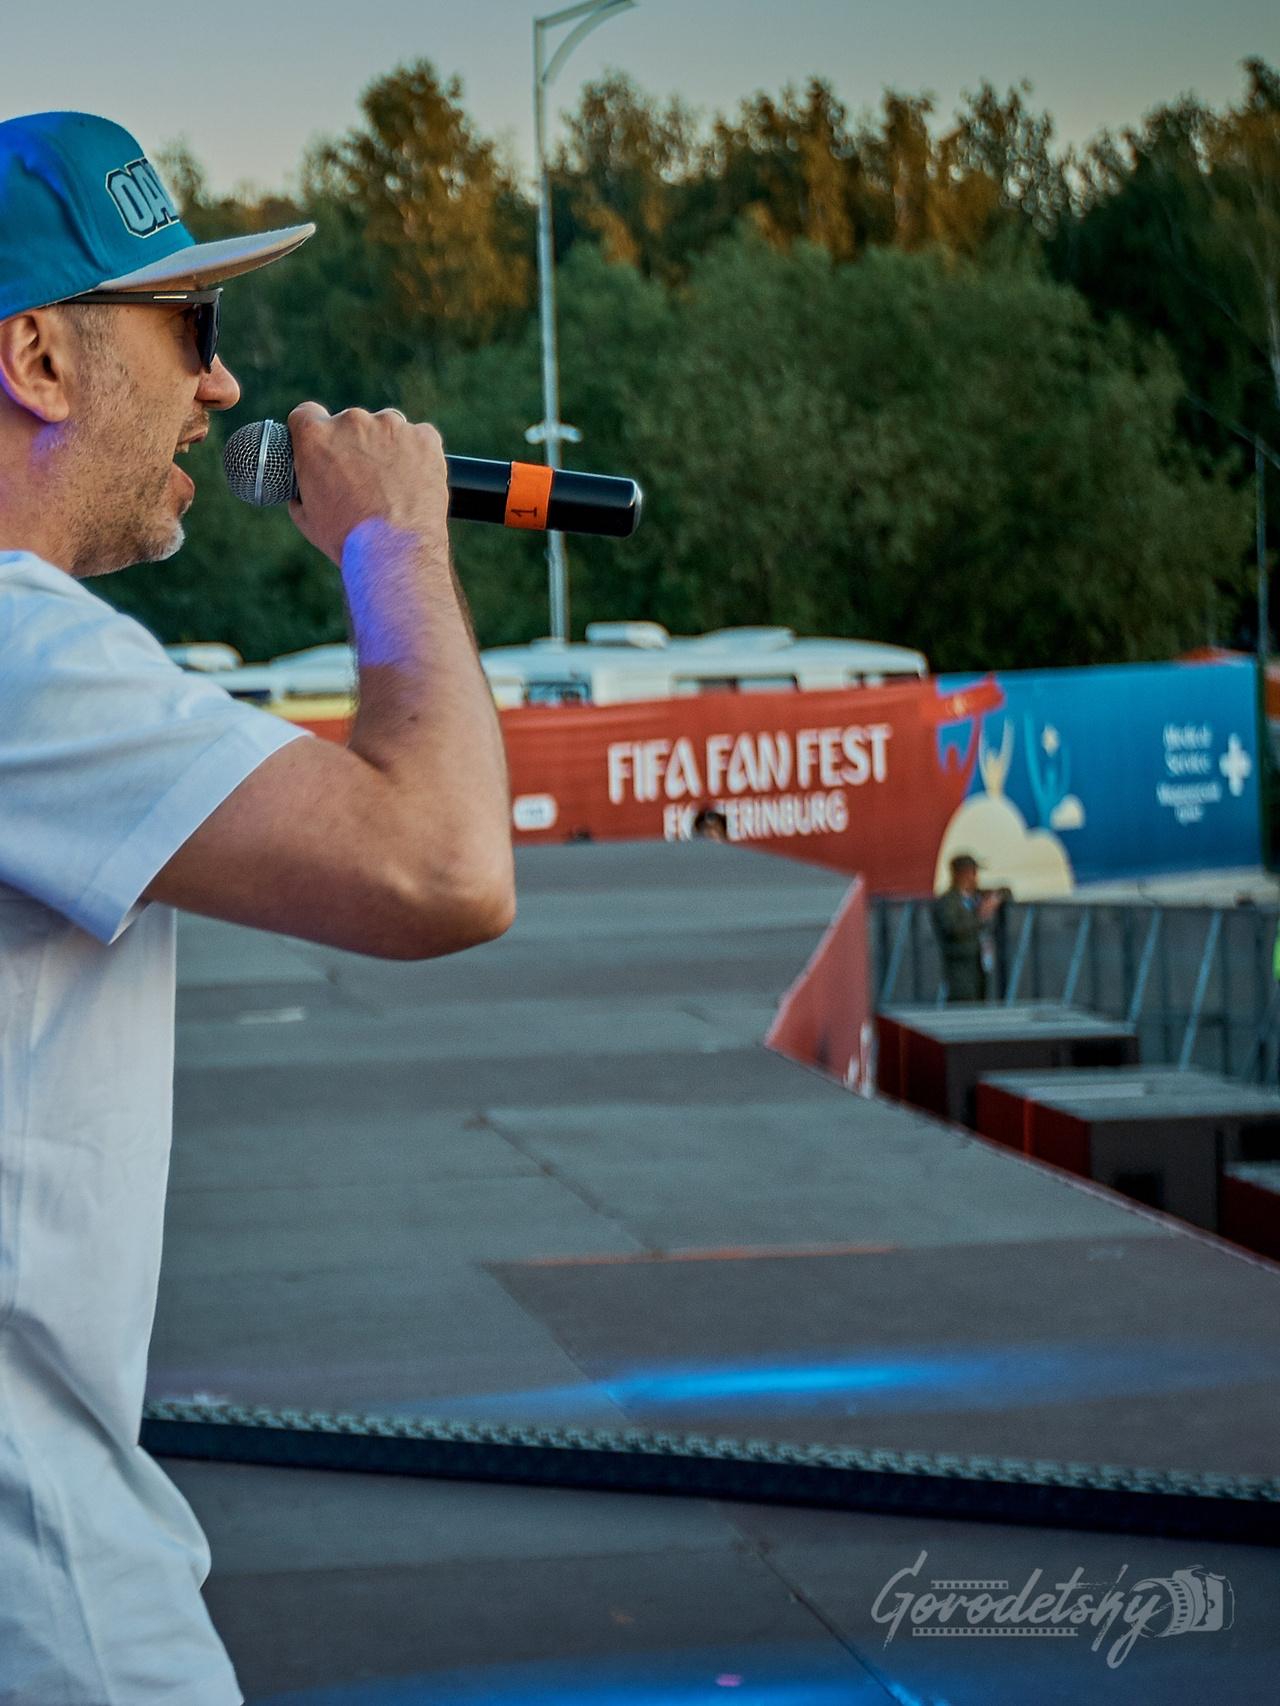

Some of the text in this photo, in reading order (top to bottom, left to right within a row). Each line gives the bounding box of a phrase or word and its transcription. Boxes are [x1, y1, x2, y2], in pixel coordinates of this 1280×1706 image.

[607, 722, 893, 805] FIFA FAN FEST
[663, 787, 849, 842] EKERINBURG
